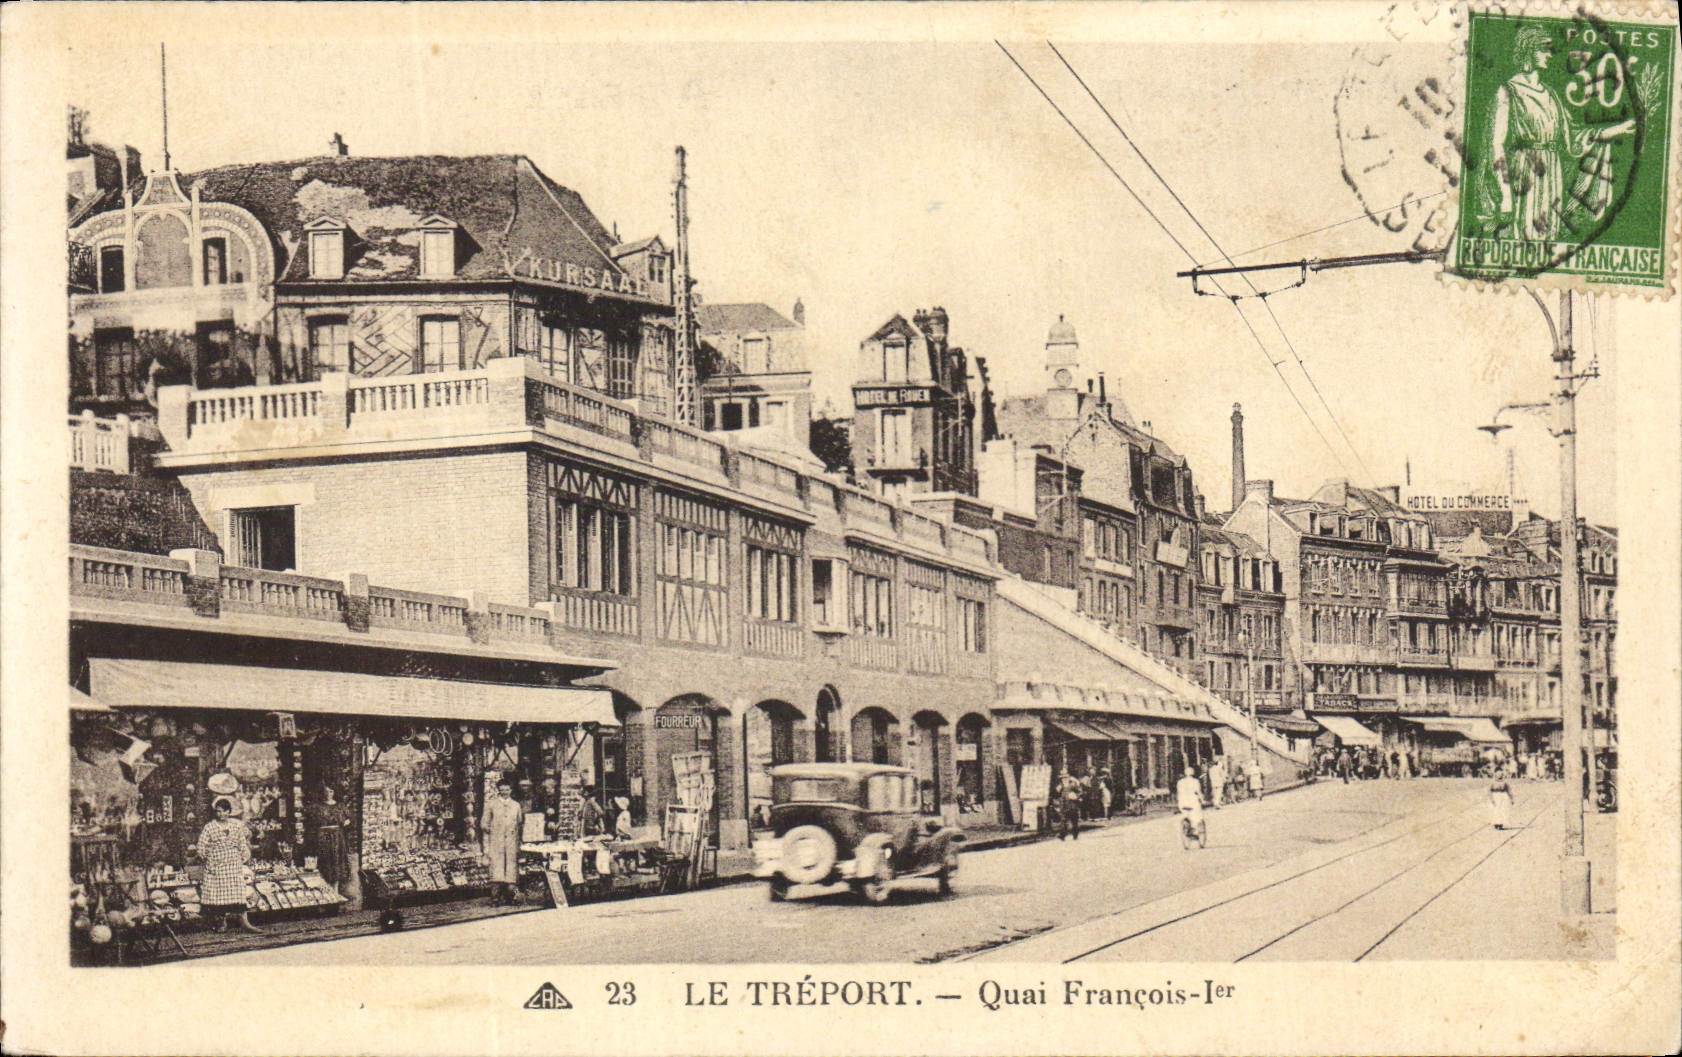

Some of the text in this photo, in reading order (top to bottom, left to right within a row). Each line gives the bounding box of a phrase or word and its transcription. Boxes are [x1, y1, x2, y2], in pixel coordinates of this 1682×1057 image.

[1564, 244, 1660, 275] FRANÇAISE
[1407, 495, 1439, 509] HOTEL
[1457, 495, 1509, 509] COMMERCE
[655, 715, 701, 728] FOURREUR
